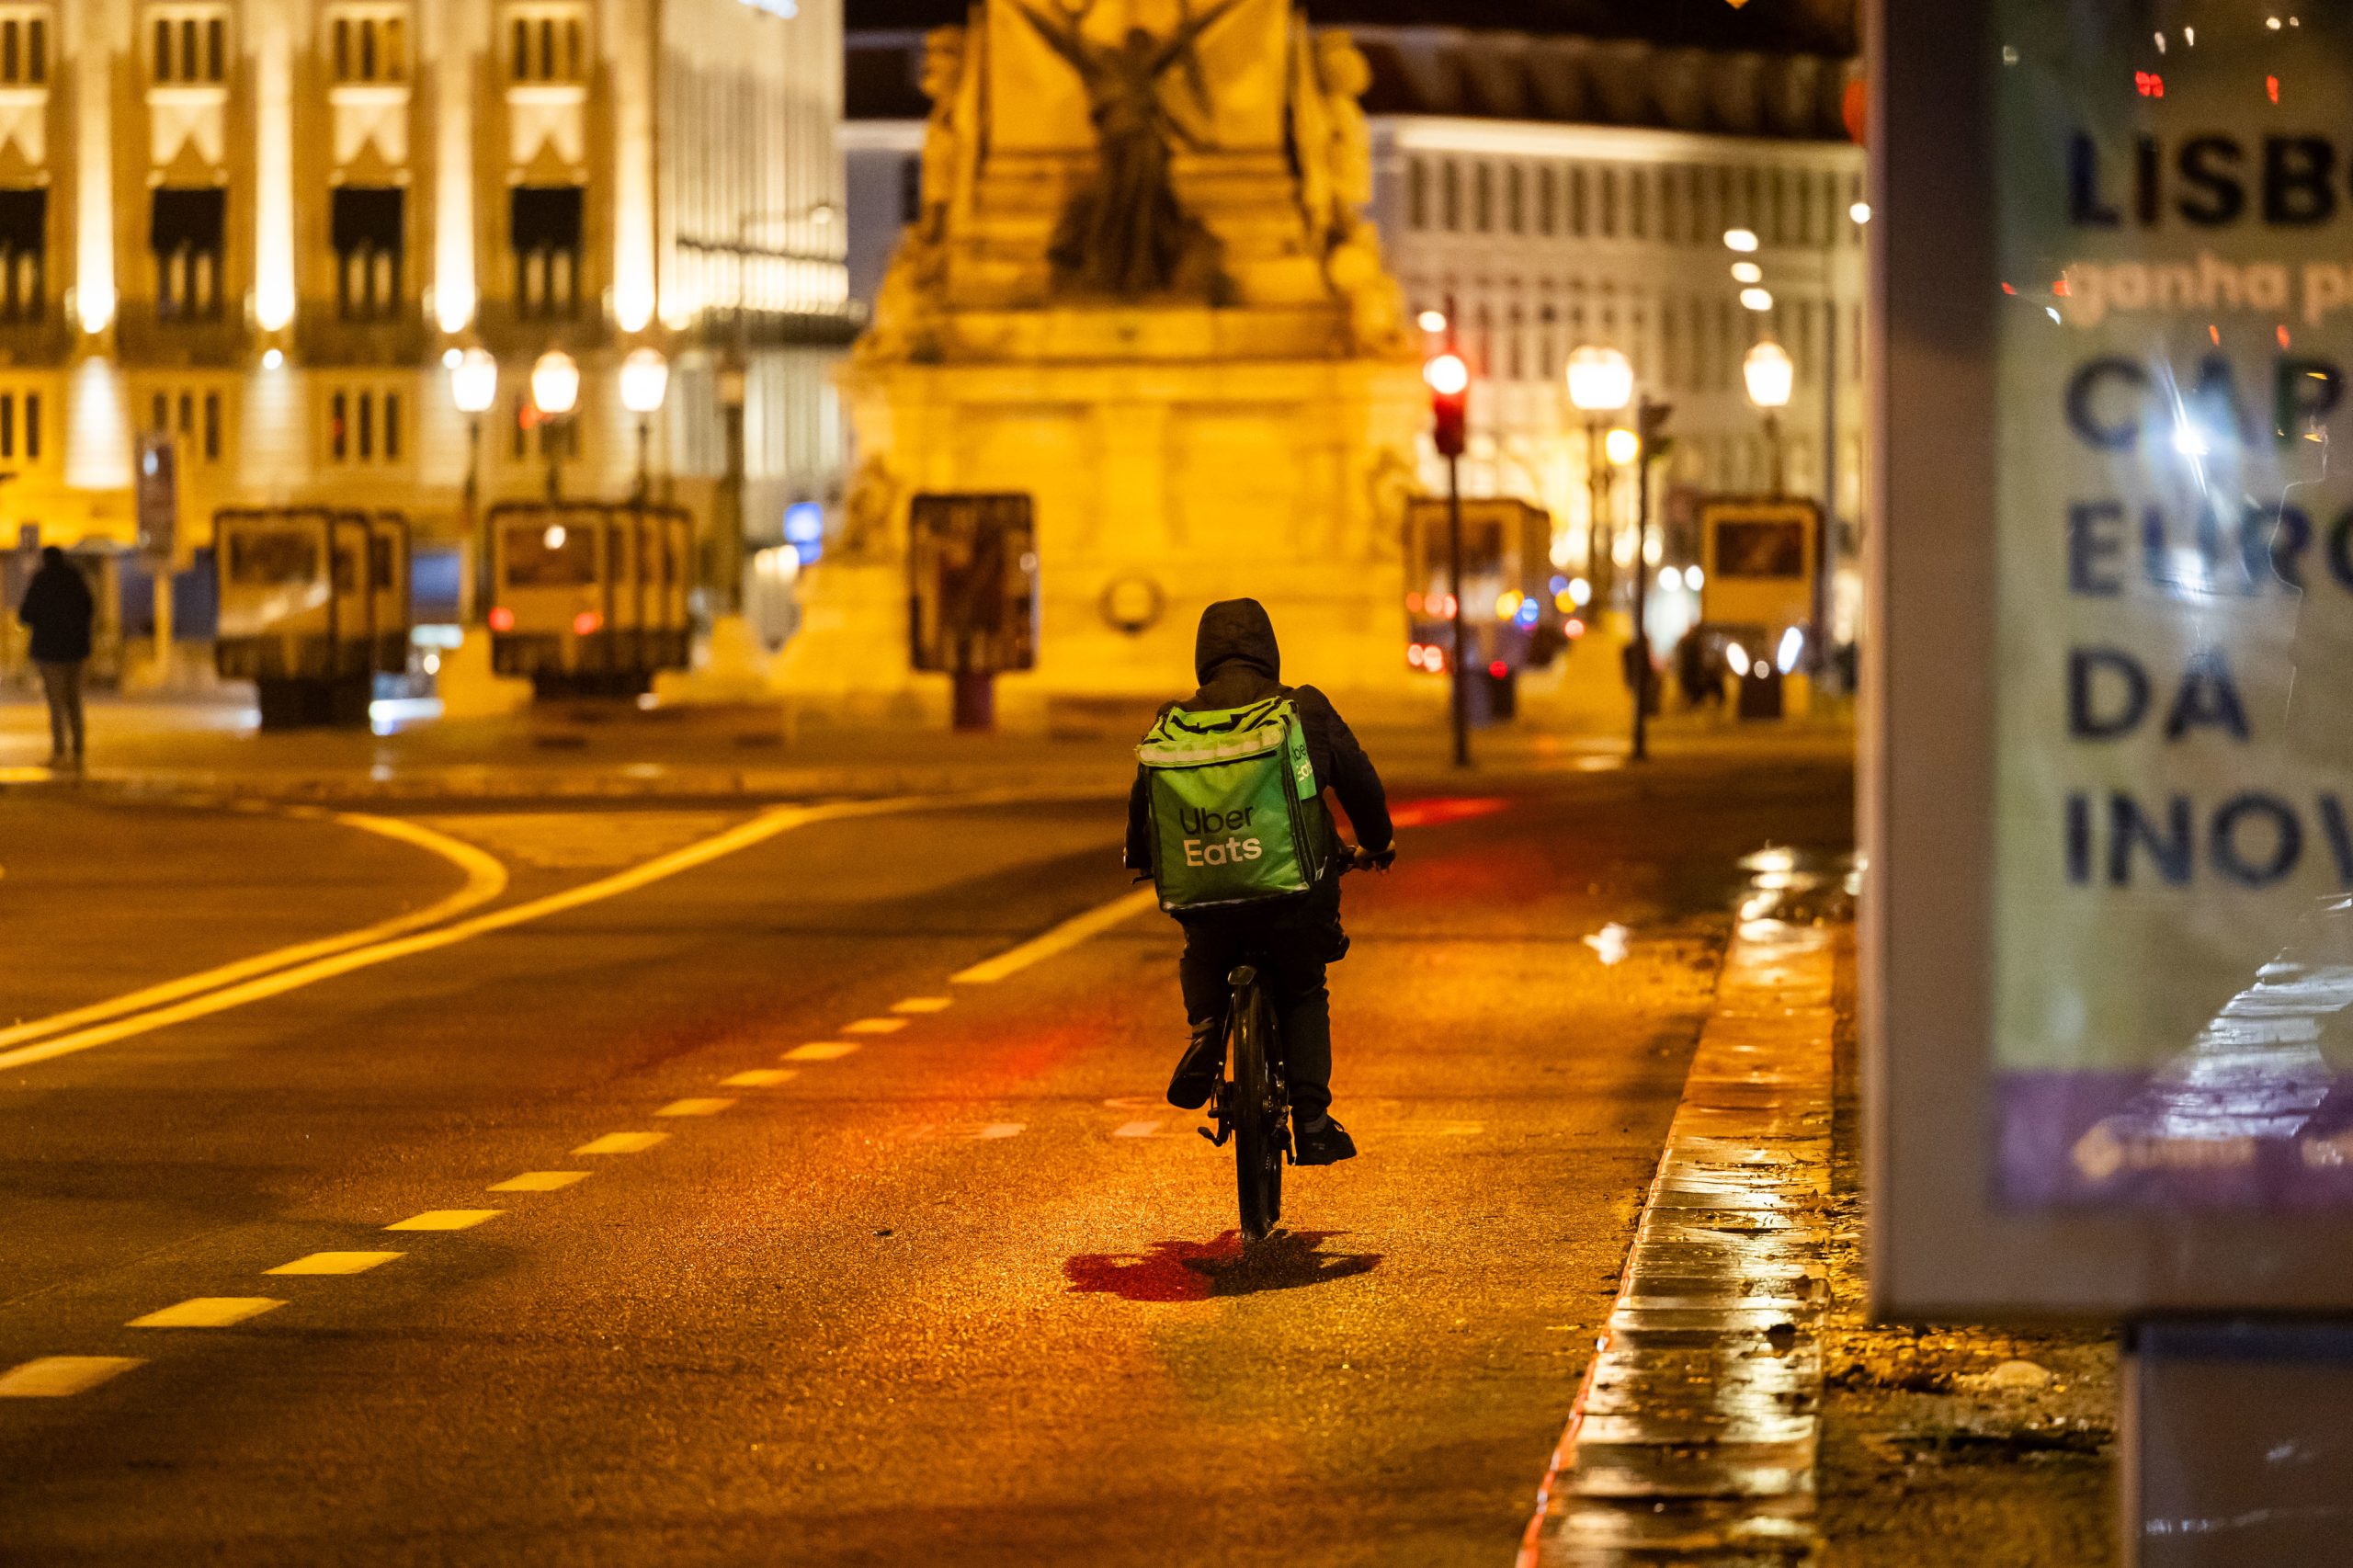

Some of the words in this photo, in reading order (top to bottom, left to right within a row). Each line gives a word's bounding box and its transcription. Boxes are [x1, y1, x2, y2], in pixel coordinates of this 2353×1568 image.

[2068, 131, 2353, 229] LISB
[2064, 253, 2289, 325] ganha
[2066, 646, 2252, 742] DA
[1179, 806, 1253, 835] Uber
[1184, 837, 1262, 867] Eats
